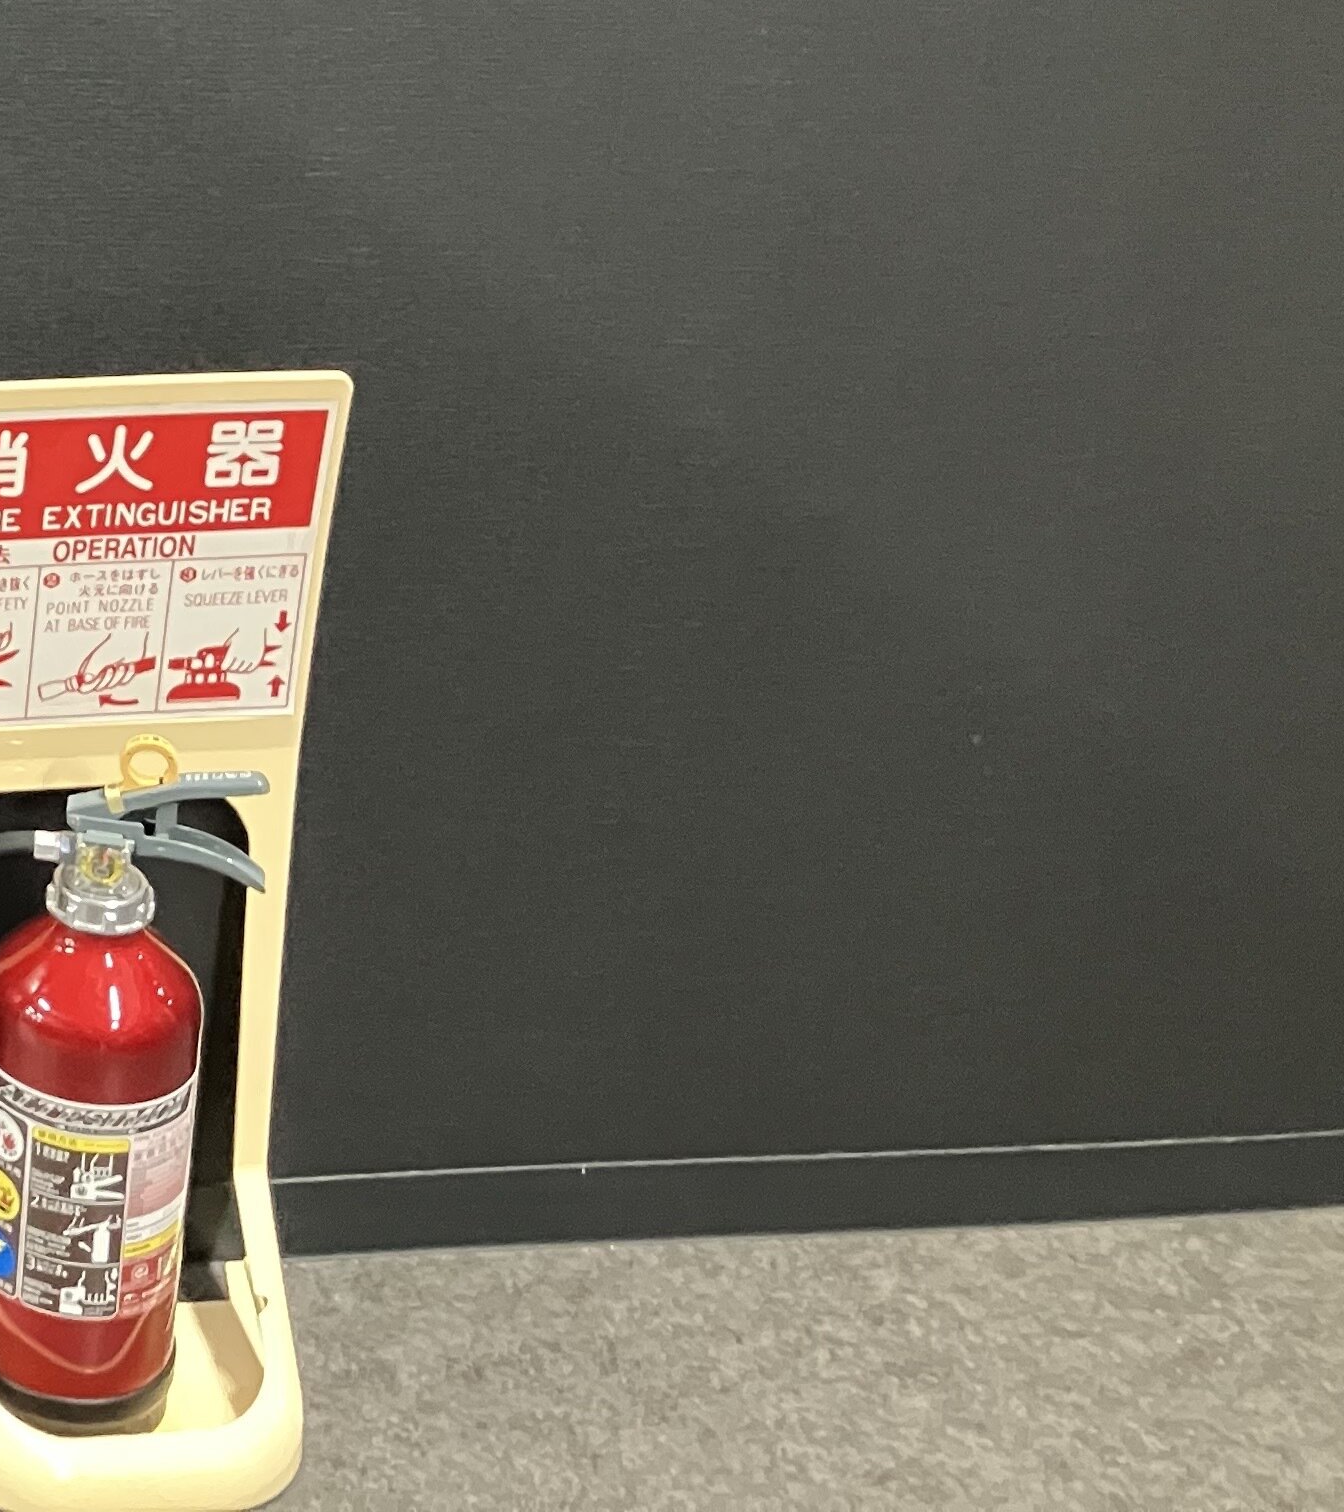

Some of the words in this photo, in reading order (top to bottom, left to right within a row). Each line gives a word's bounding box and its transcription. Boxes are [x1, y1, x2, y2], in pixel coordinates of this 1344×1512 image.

[42, 497, 272, 531] EXTINGUISHER
[52, 534, 196, 563] OPERATION
[46, 600, 90, 615] POINT
[98, 598, 154, 613] NOZZLE
[184, 591, 244, 607] SQUEEZE
[246, 588, 288, 605] LEVER
[44, 619, 60, 633] AT
[67, 617, 101, 632] BASE
[104, 616, 121, 630] OF
[124, 615, 151, 630] FIRE
